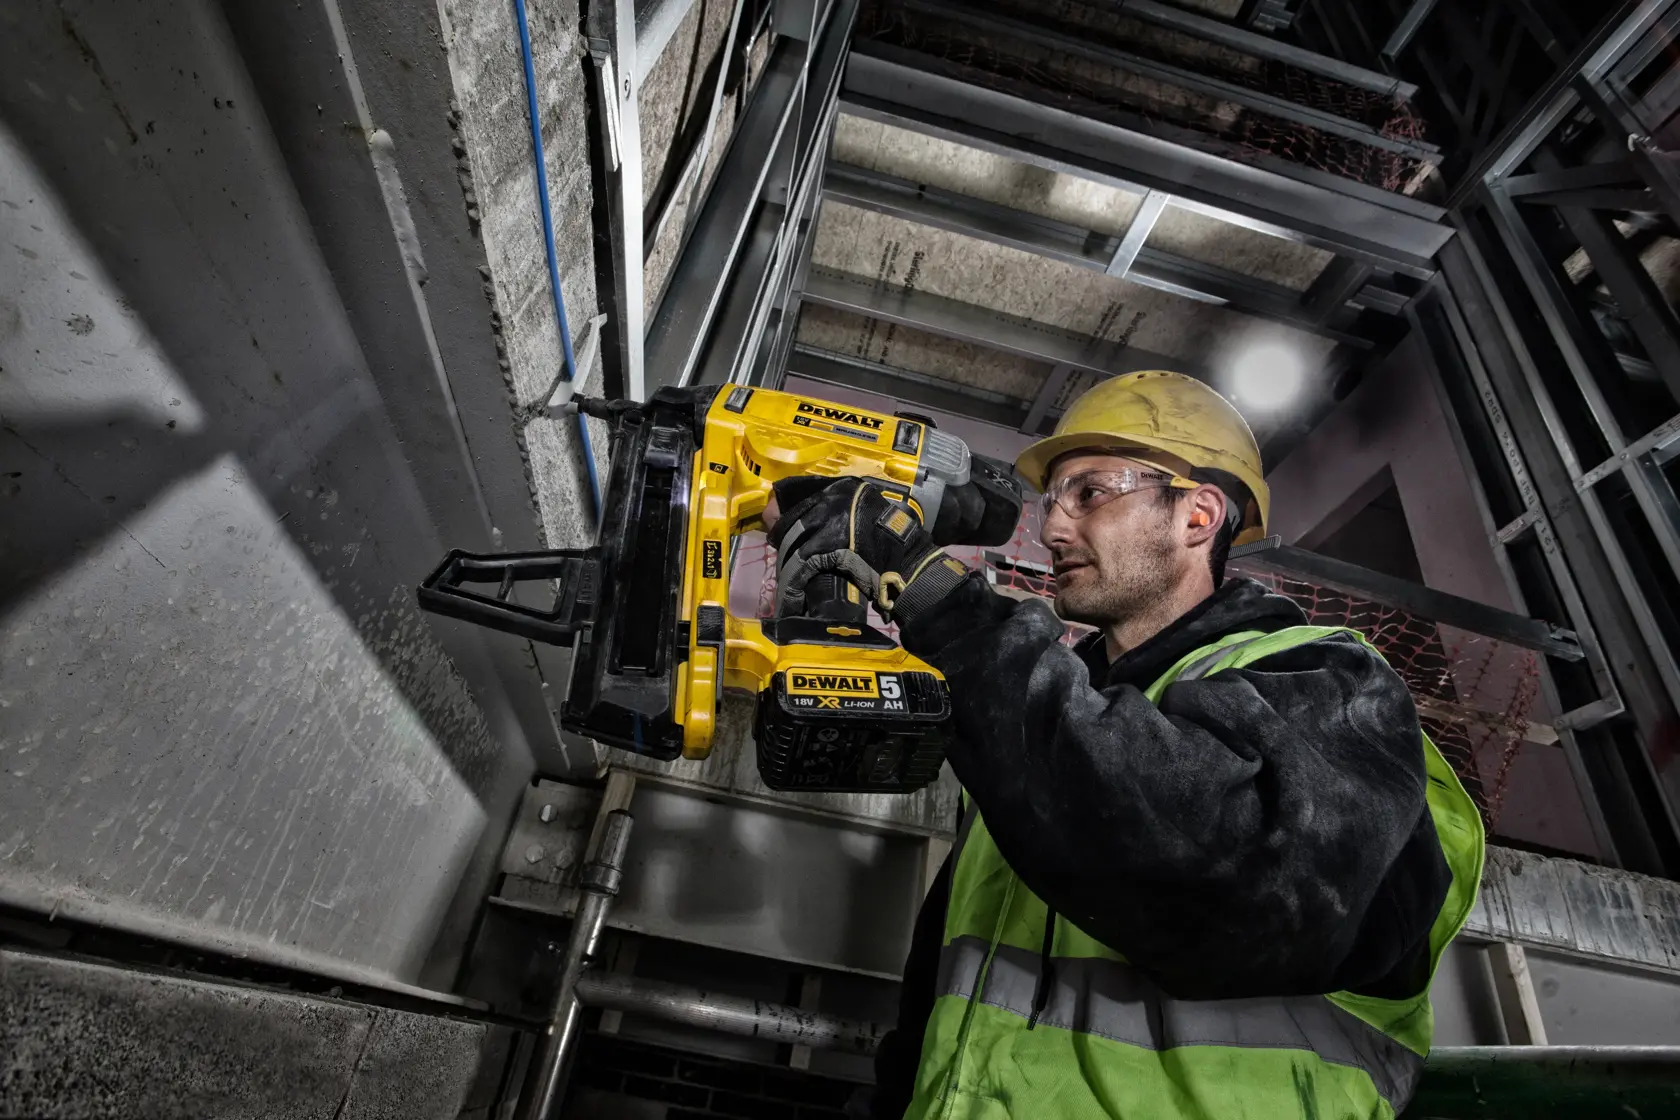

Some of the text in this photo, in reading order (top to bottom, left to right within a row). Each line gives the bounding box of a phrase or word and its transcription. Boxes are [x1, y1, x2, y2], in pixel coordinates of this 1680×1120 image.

[797, 403, 884, 429] DEWALT
[1140, 472, 1163, 480] DEWALT
[792, 675, 901, 699] DEWALT 5
[793, 698, 814, 706] 18V
[816, 696, 842, 709] XR
[883, 700, 904, 710] AH
